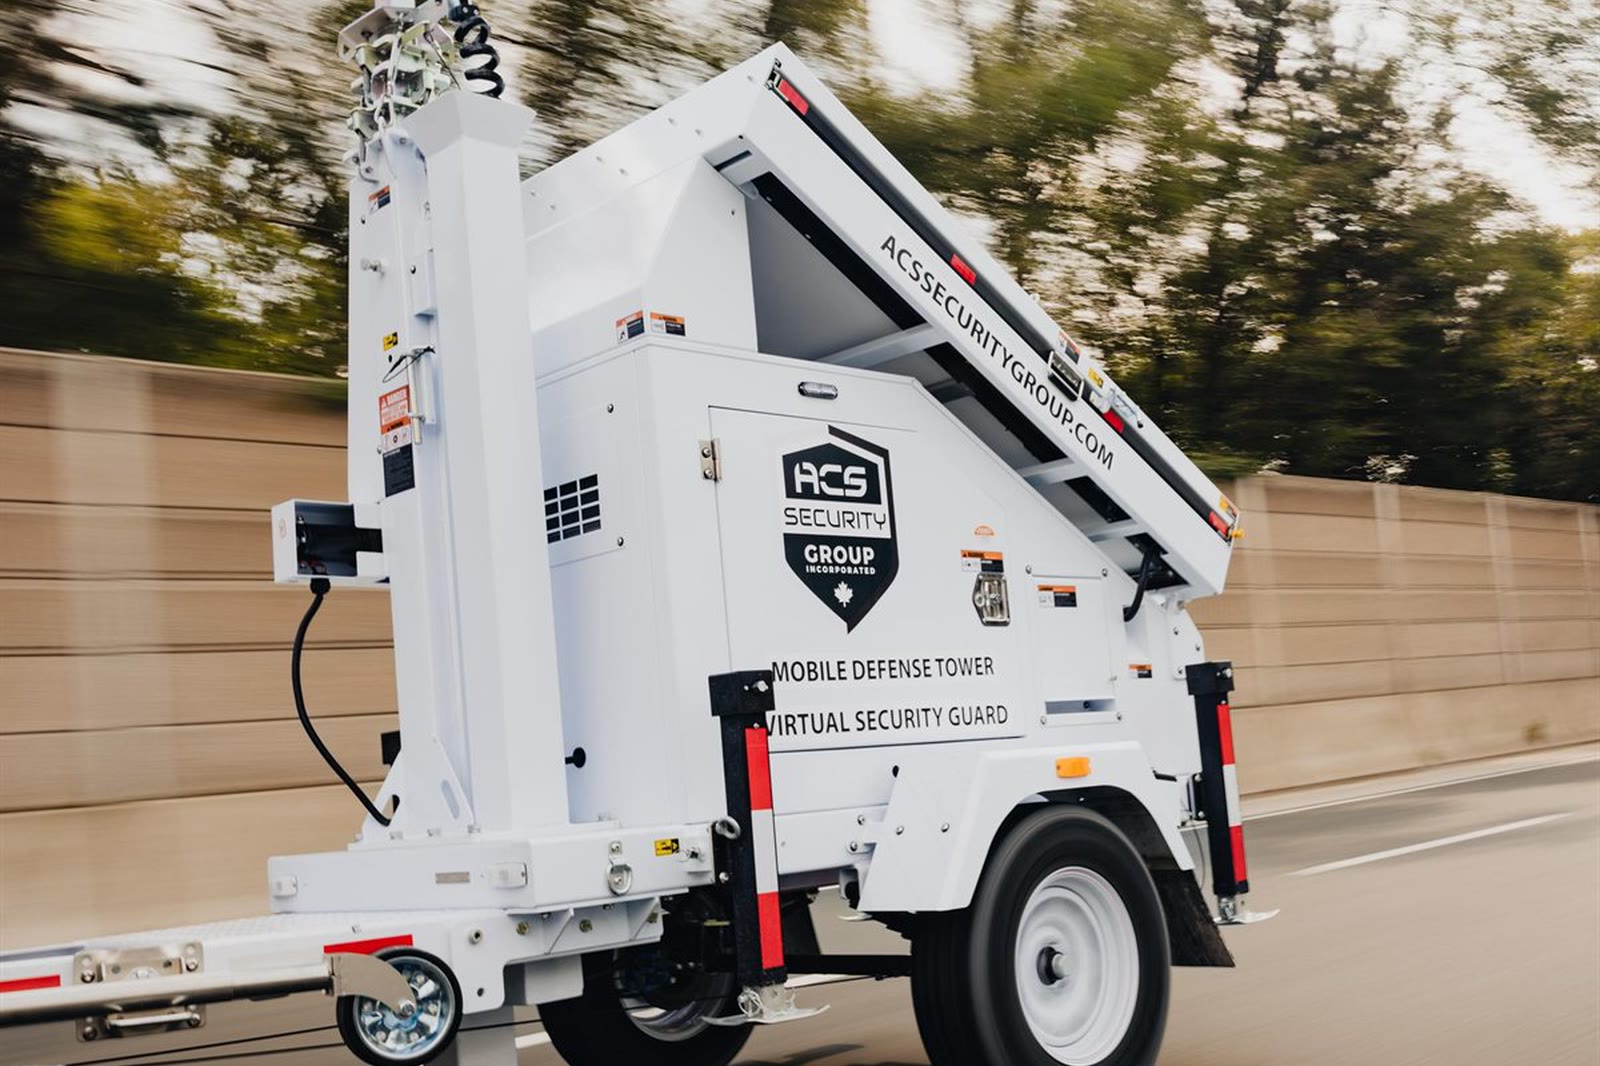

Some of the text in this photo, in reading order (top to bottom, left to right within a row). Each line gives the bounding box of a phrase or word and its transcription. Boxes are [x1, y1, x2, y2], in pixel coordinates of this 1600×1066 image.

[880, 235, 1114, 470] ACSSECURITYGROUP.COM
[793, 461, 868, 498] ACS
[784, 507, 886, 530] SECURITY
[804, 544, 875, 565] GROUP
[805, 564, 876, 575] INCORPORATED
[772, 657, 994, 682] MOBILE DEFENSE TOWER
[856, 707, 943, 731] SECURITY
[948, 705, 1009, 726] GUARD
